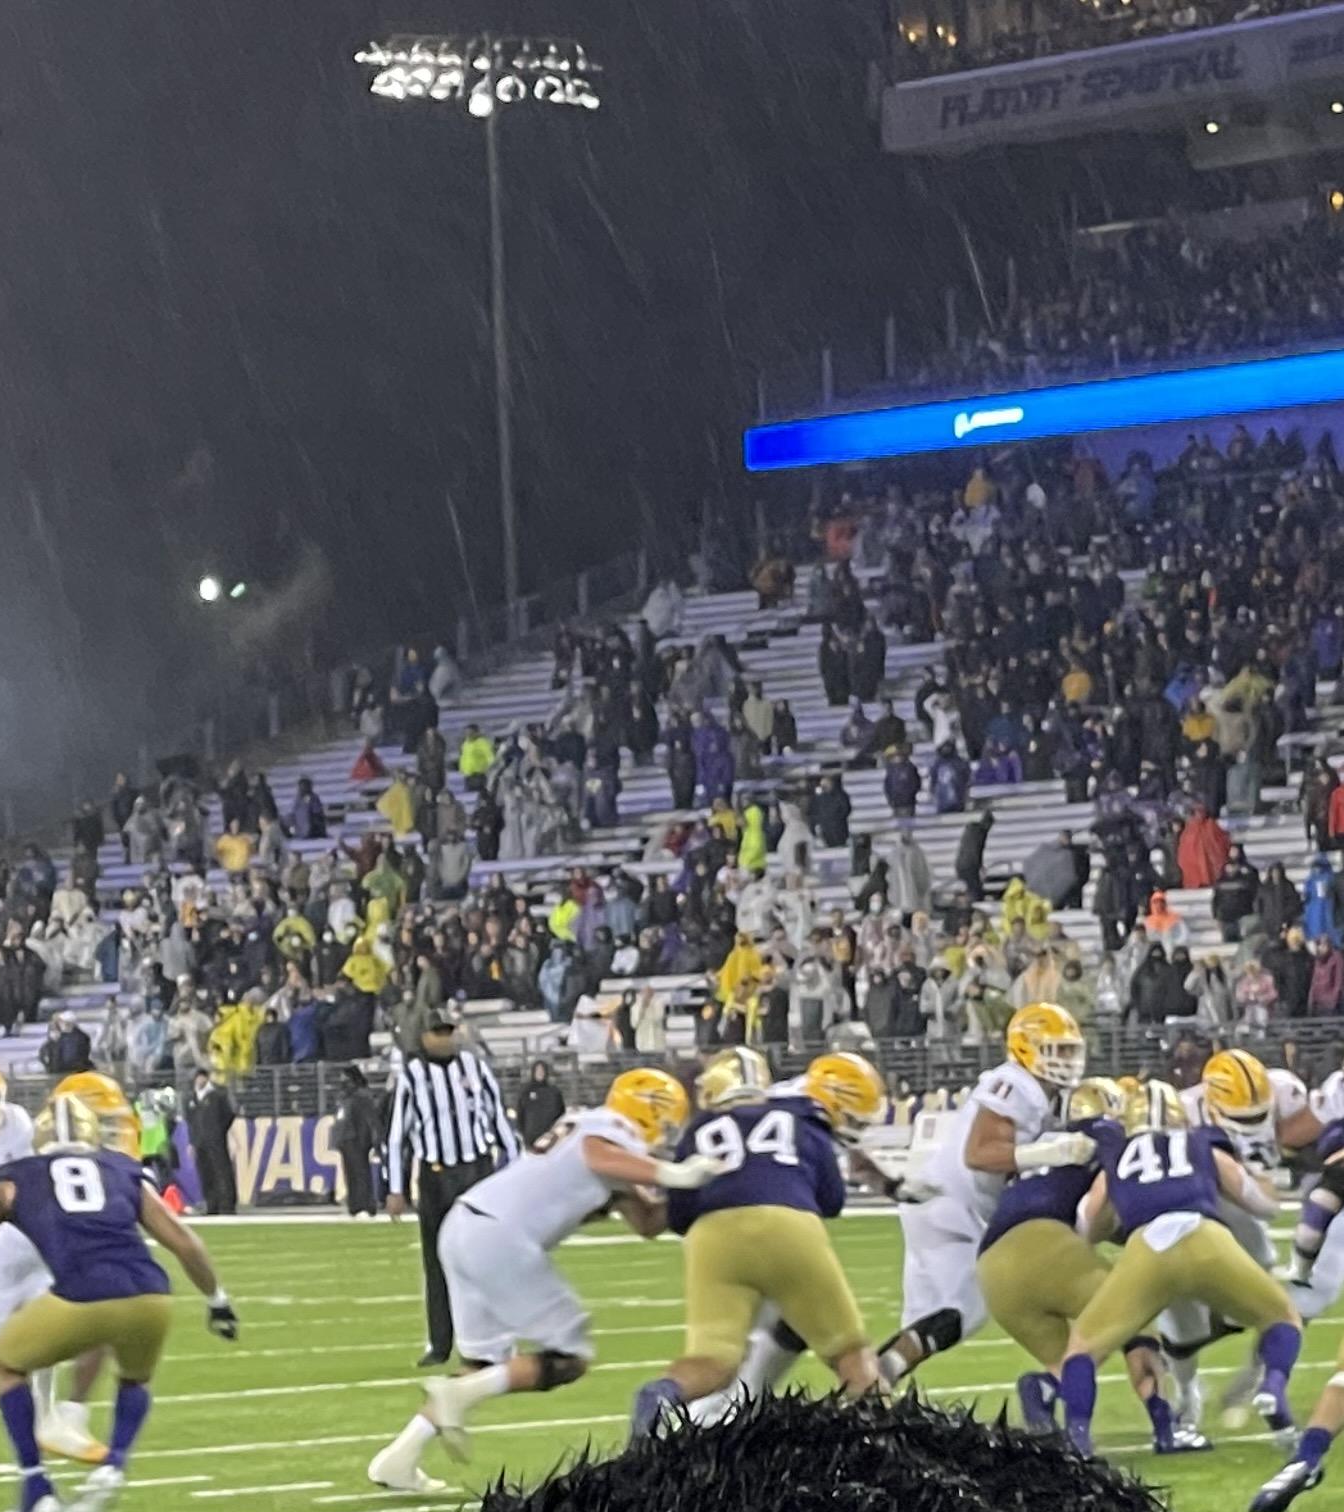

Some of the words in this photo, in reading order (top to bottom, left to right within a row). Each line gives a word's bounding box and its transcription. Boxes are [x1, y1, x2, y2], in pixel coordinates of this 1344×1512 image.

[694, 1109, 800, 1175] 94
[1116, 1130, 1194, 1184] 41
[49, 1156, 105, 1213] 8
